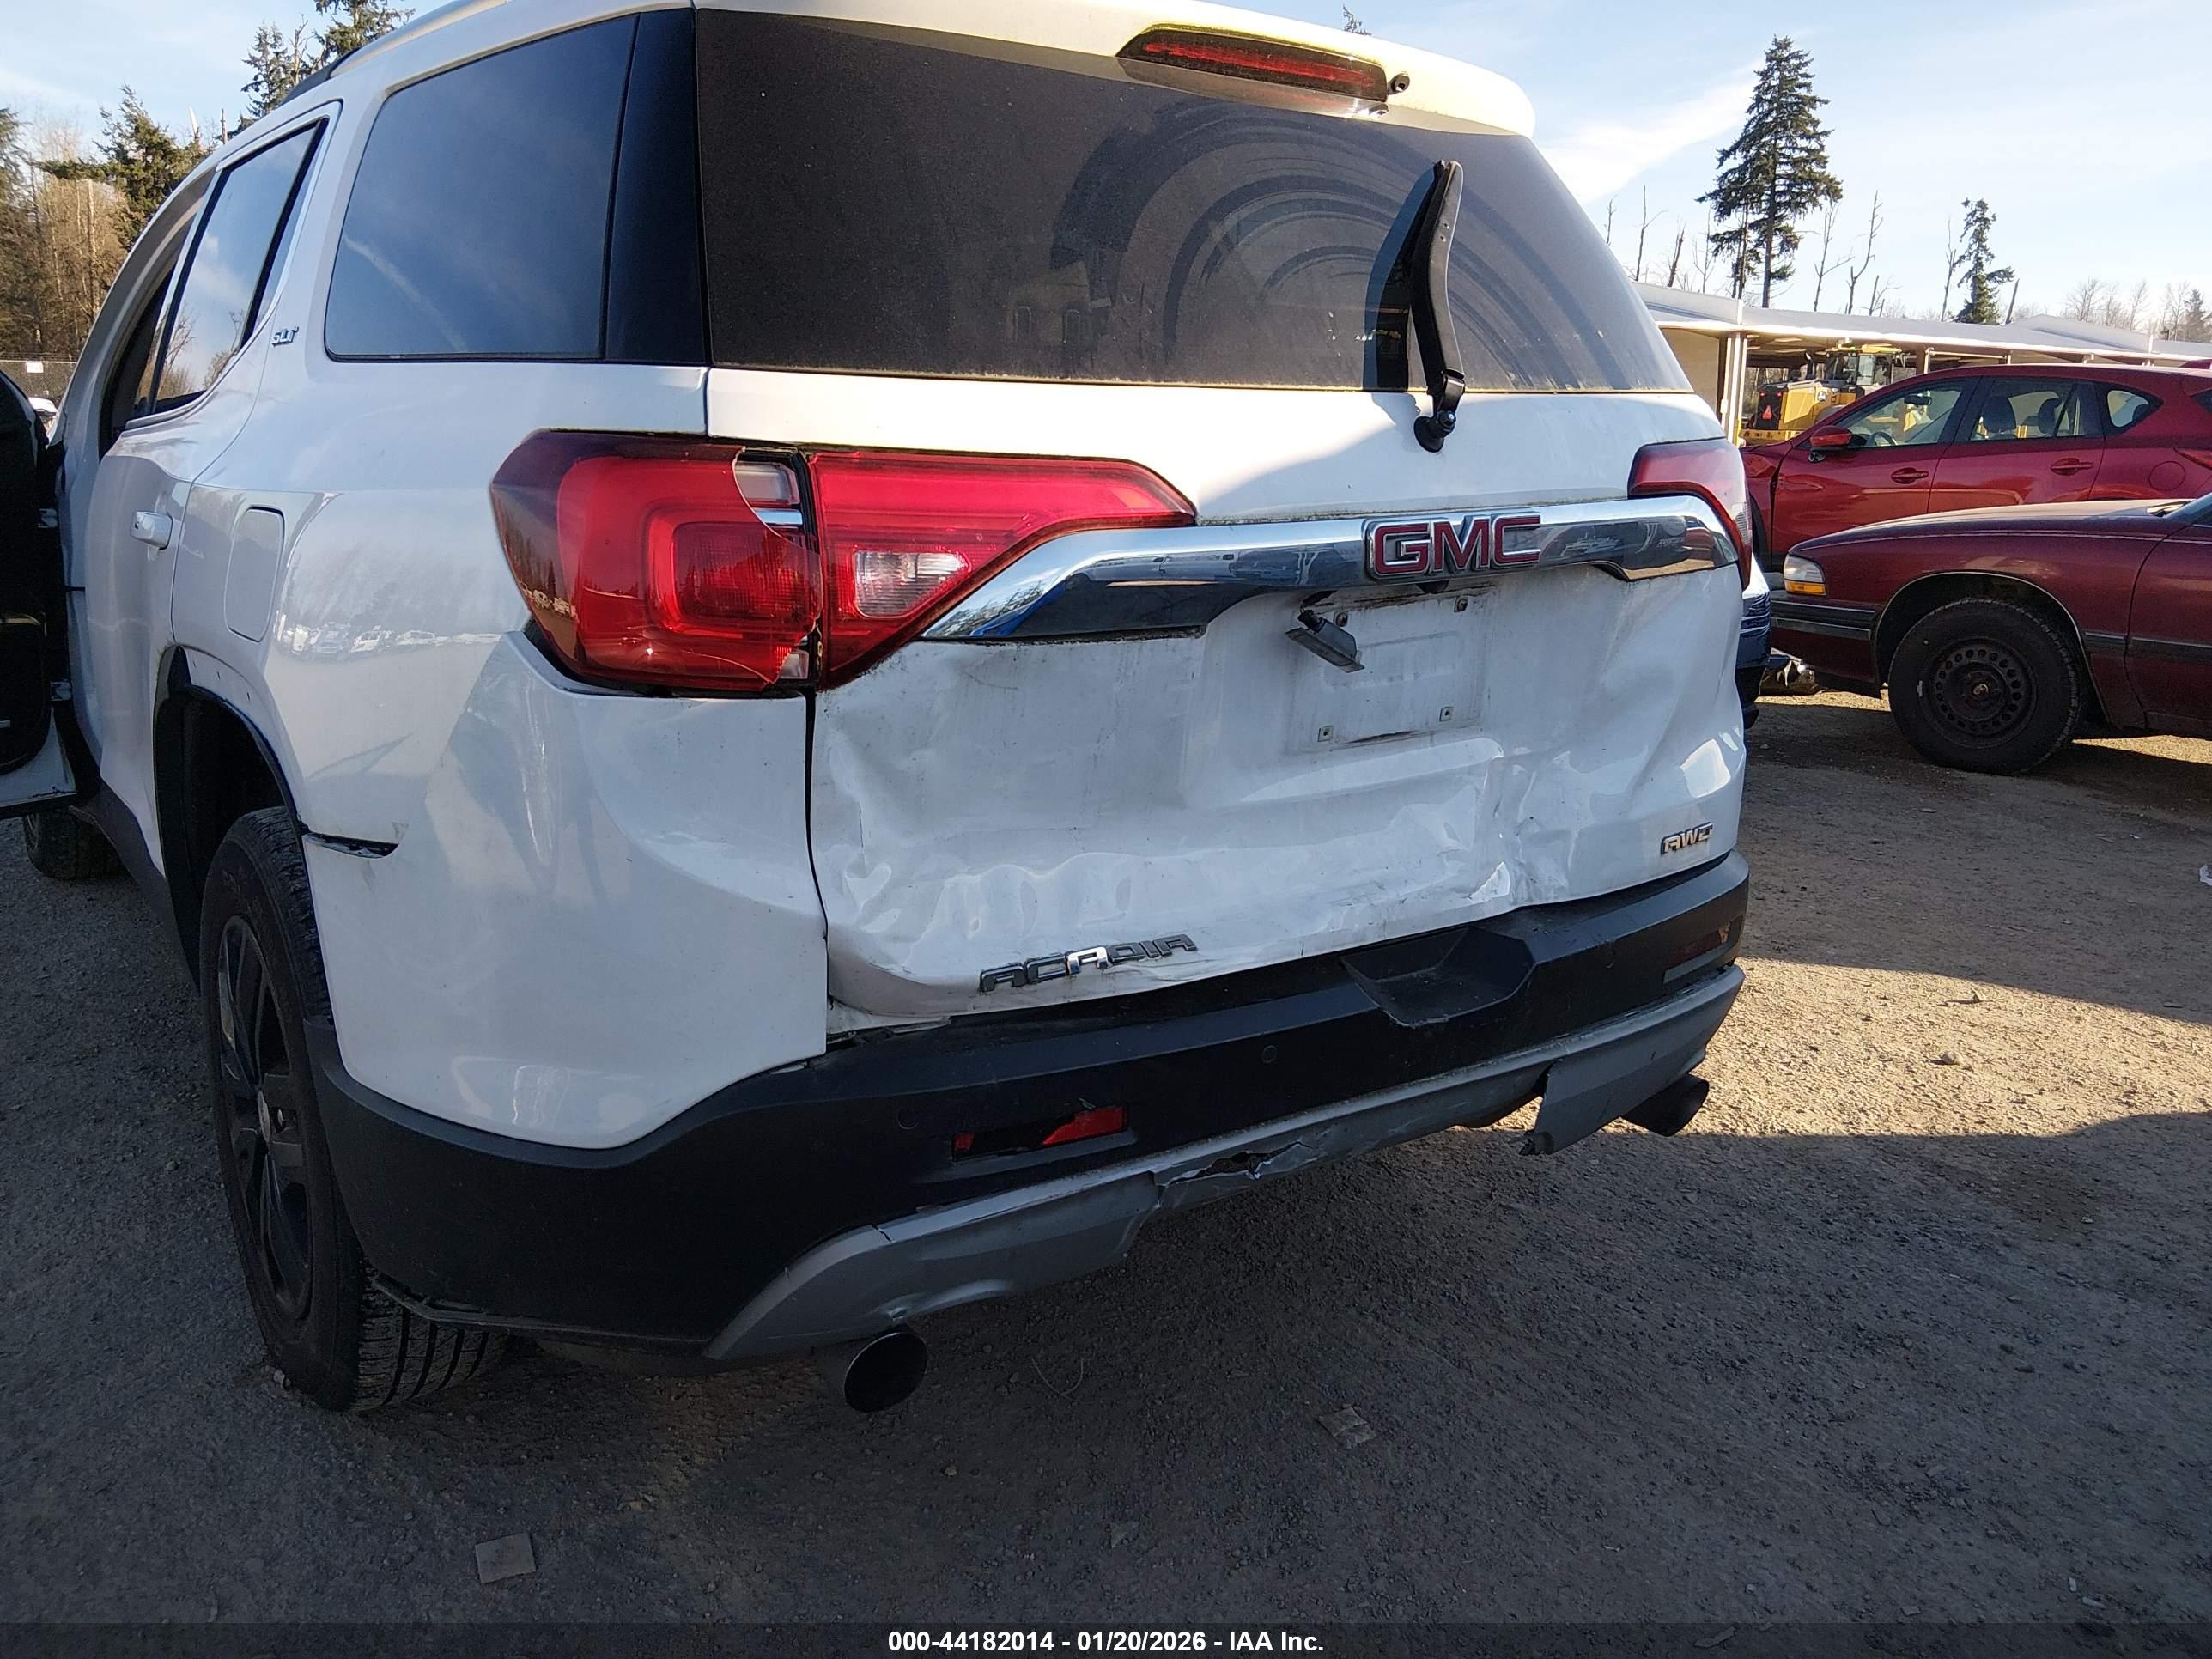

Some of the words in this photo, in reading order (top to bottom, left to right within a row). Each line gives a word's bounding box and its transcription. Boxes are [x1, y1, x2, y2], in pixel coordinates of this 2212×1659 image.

[271, 326, 300, 347] SLT
[1369, 514, 1541, 579] GMC
[1661, 822, 1714, 855] AWD
[979, 933, 1198, 993] ACADIA
